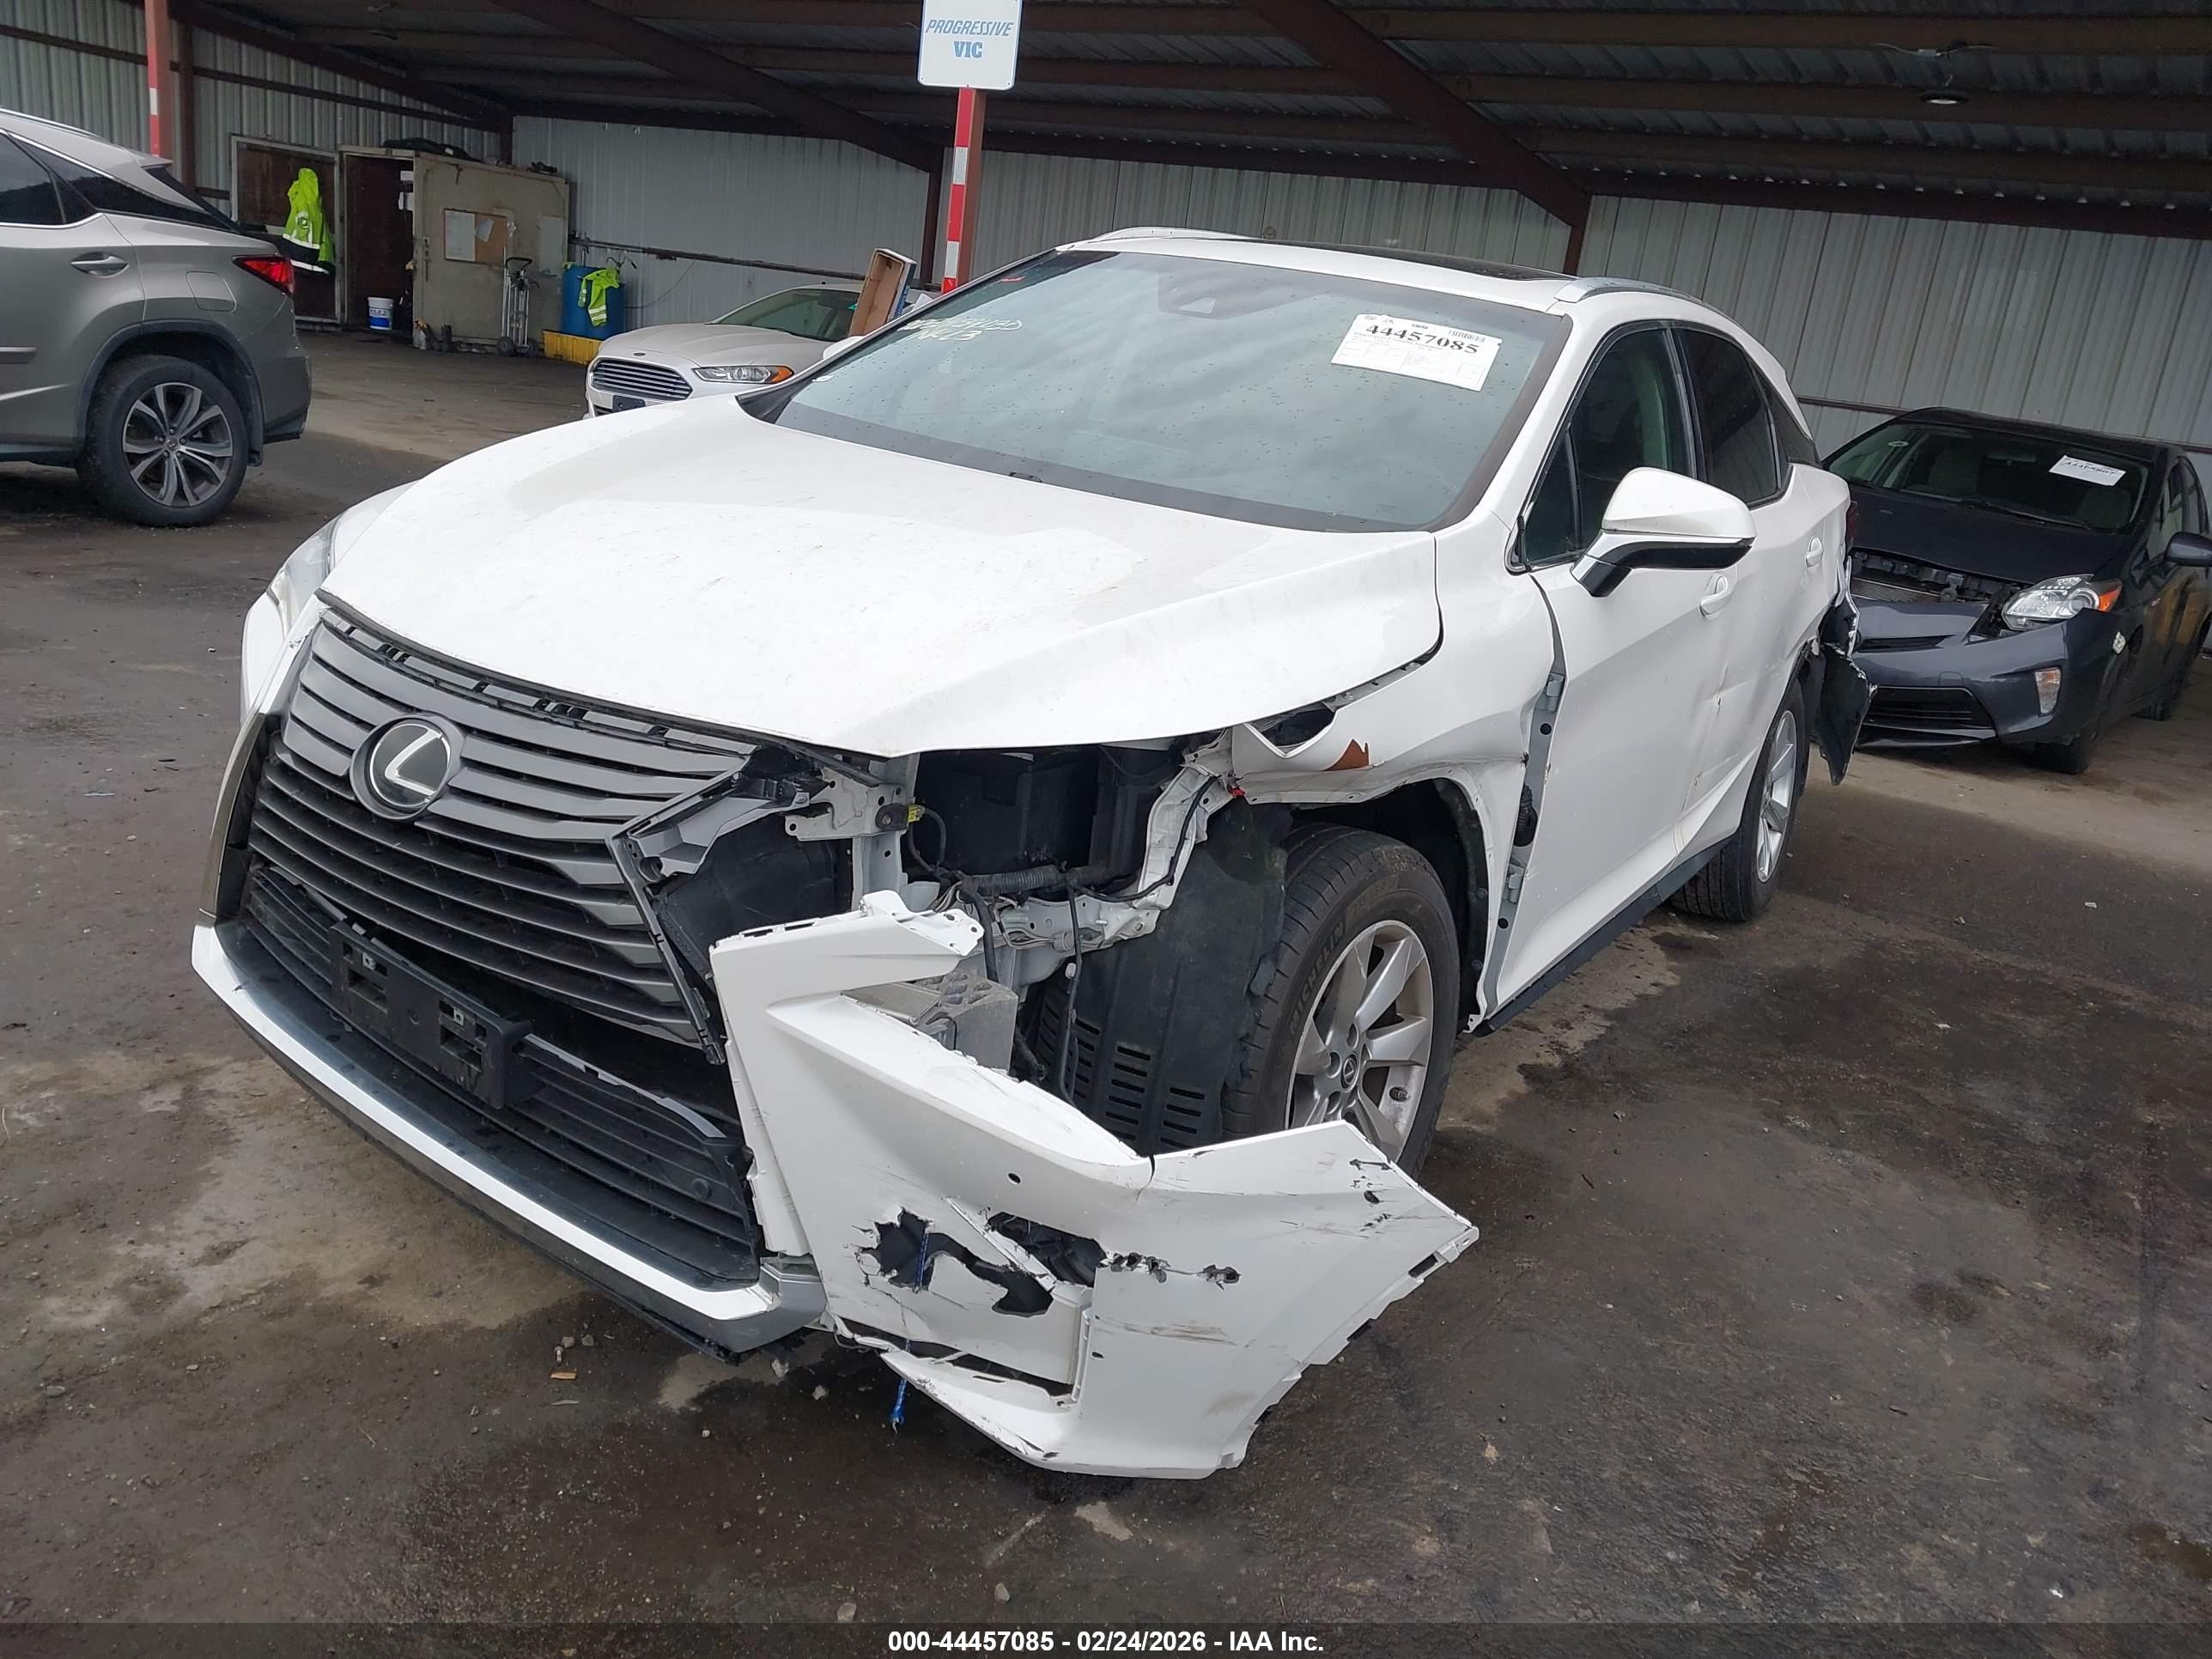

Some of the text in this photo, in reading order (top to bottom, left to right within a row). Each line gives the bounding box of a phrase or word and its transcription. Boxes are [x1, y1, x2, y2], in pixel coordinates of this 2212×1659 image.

[926, 19, 1013, 36] PROGRESSIVE
[953, 40, 983, 58] VIC
[1366, 325, 1479, 354] 44457085
